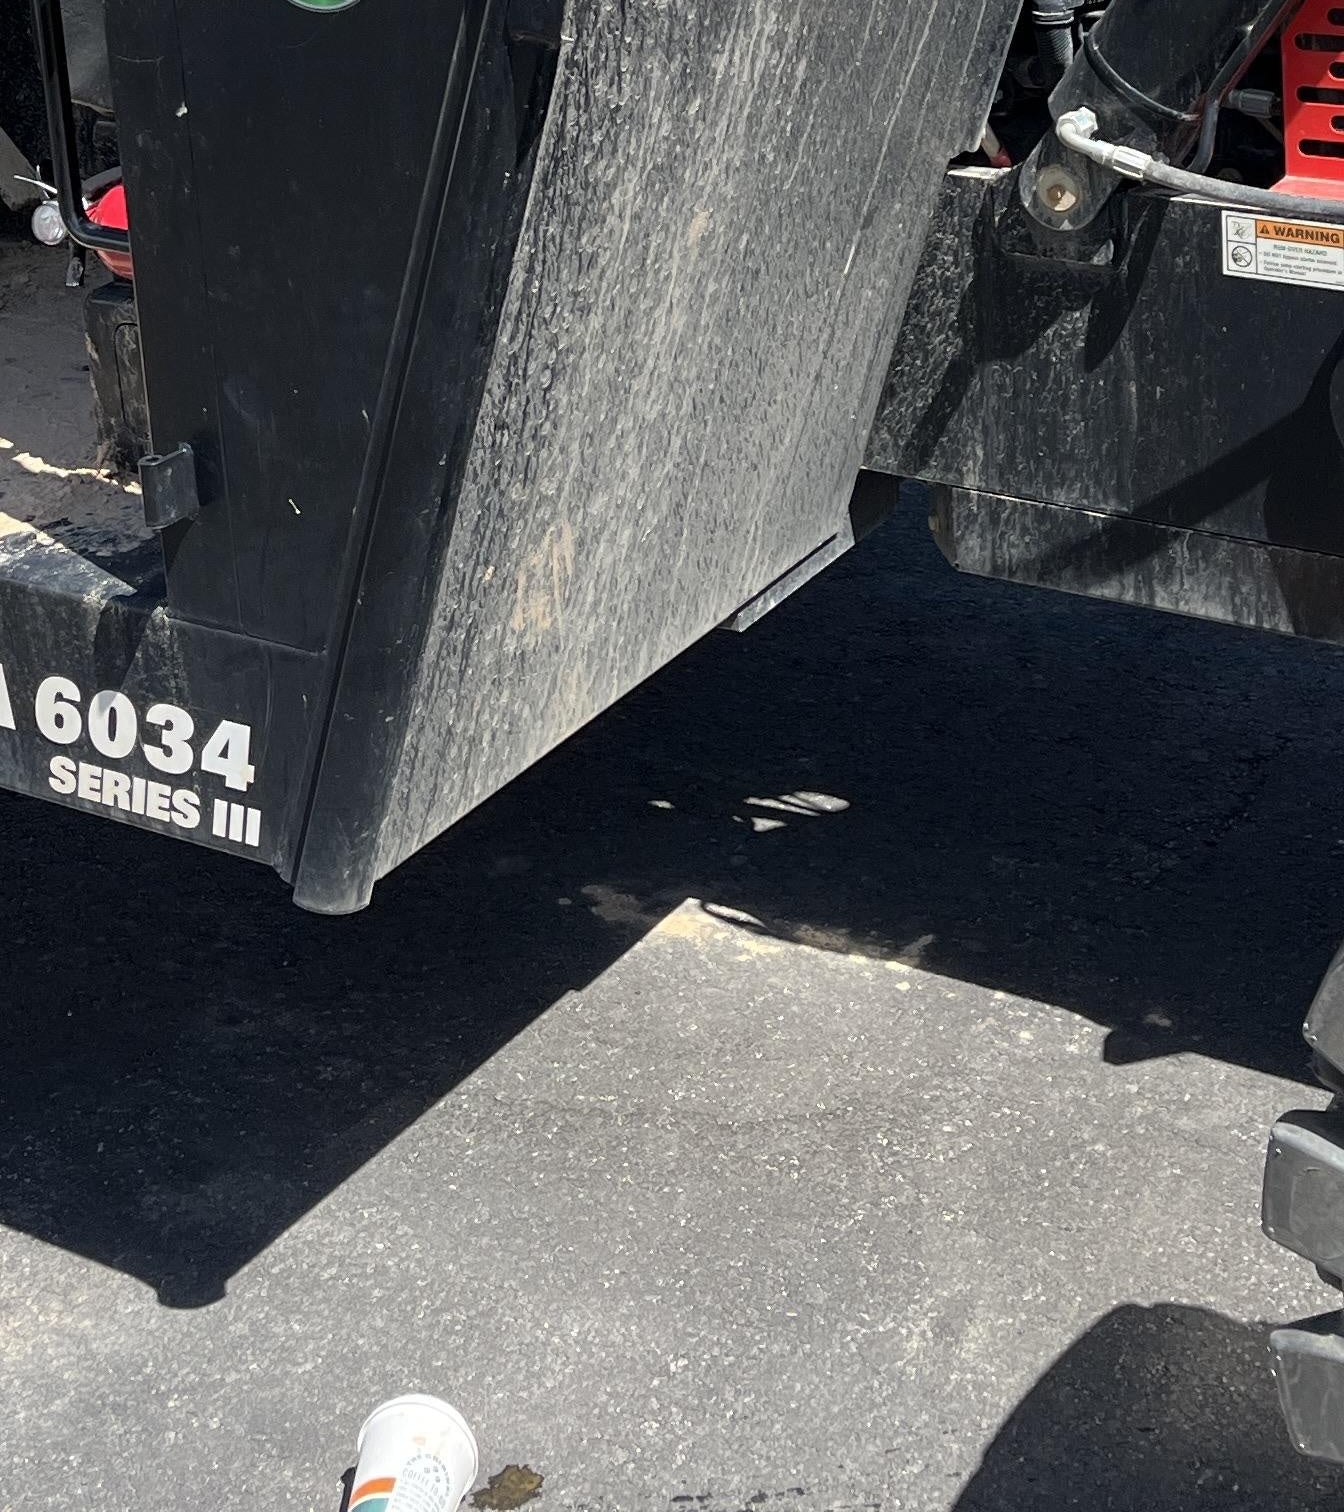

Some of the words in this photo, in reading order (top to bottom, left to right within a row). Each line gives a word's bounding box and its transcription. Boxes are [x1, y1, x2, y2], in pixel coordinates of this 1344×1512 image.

[1273, 225, 1341, 244] WARNING
[34, 675, 256, 792] 6034
[48, 754, 201, 829] SERIES
[211, 797, 262, 847] III
